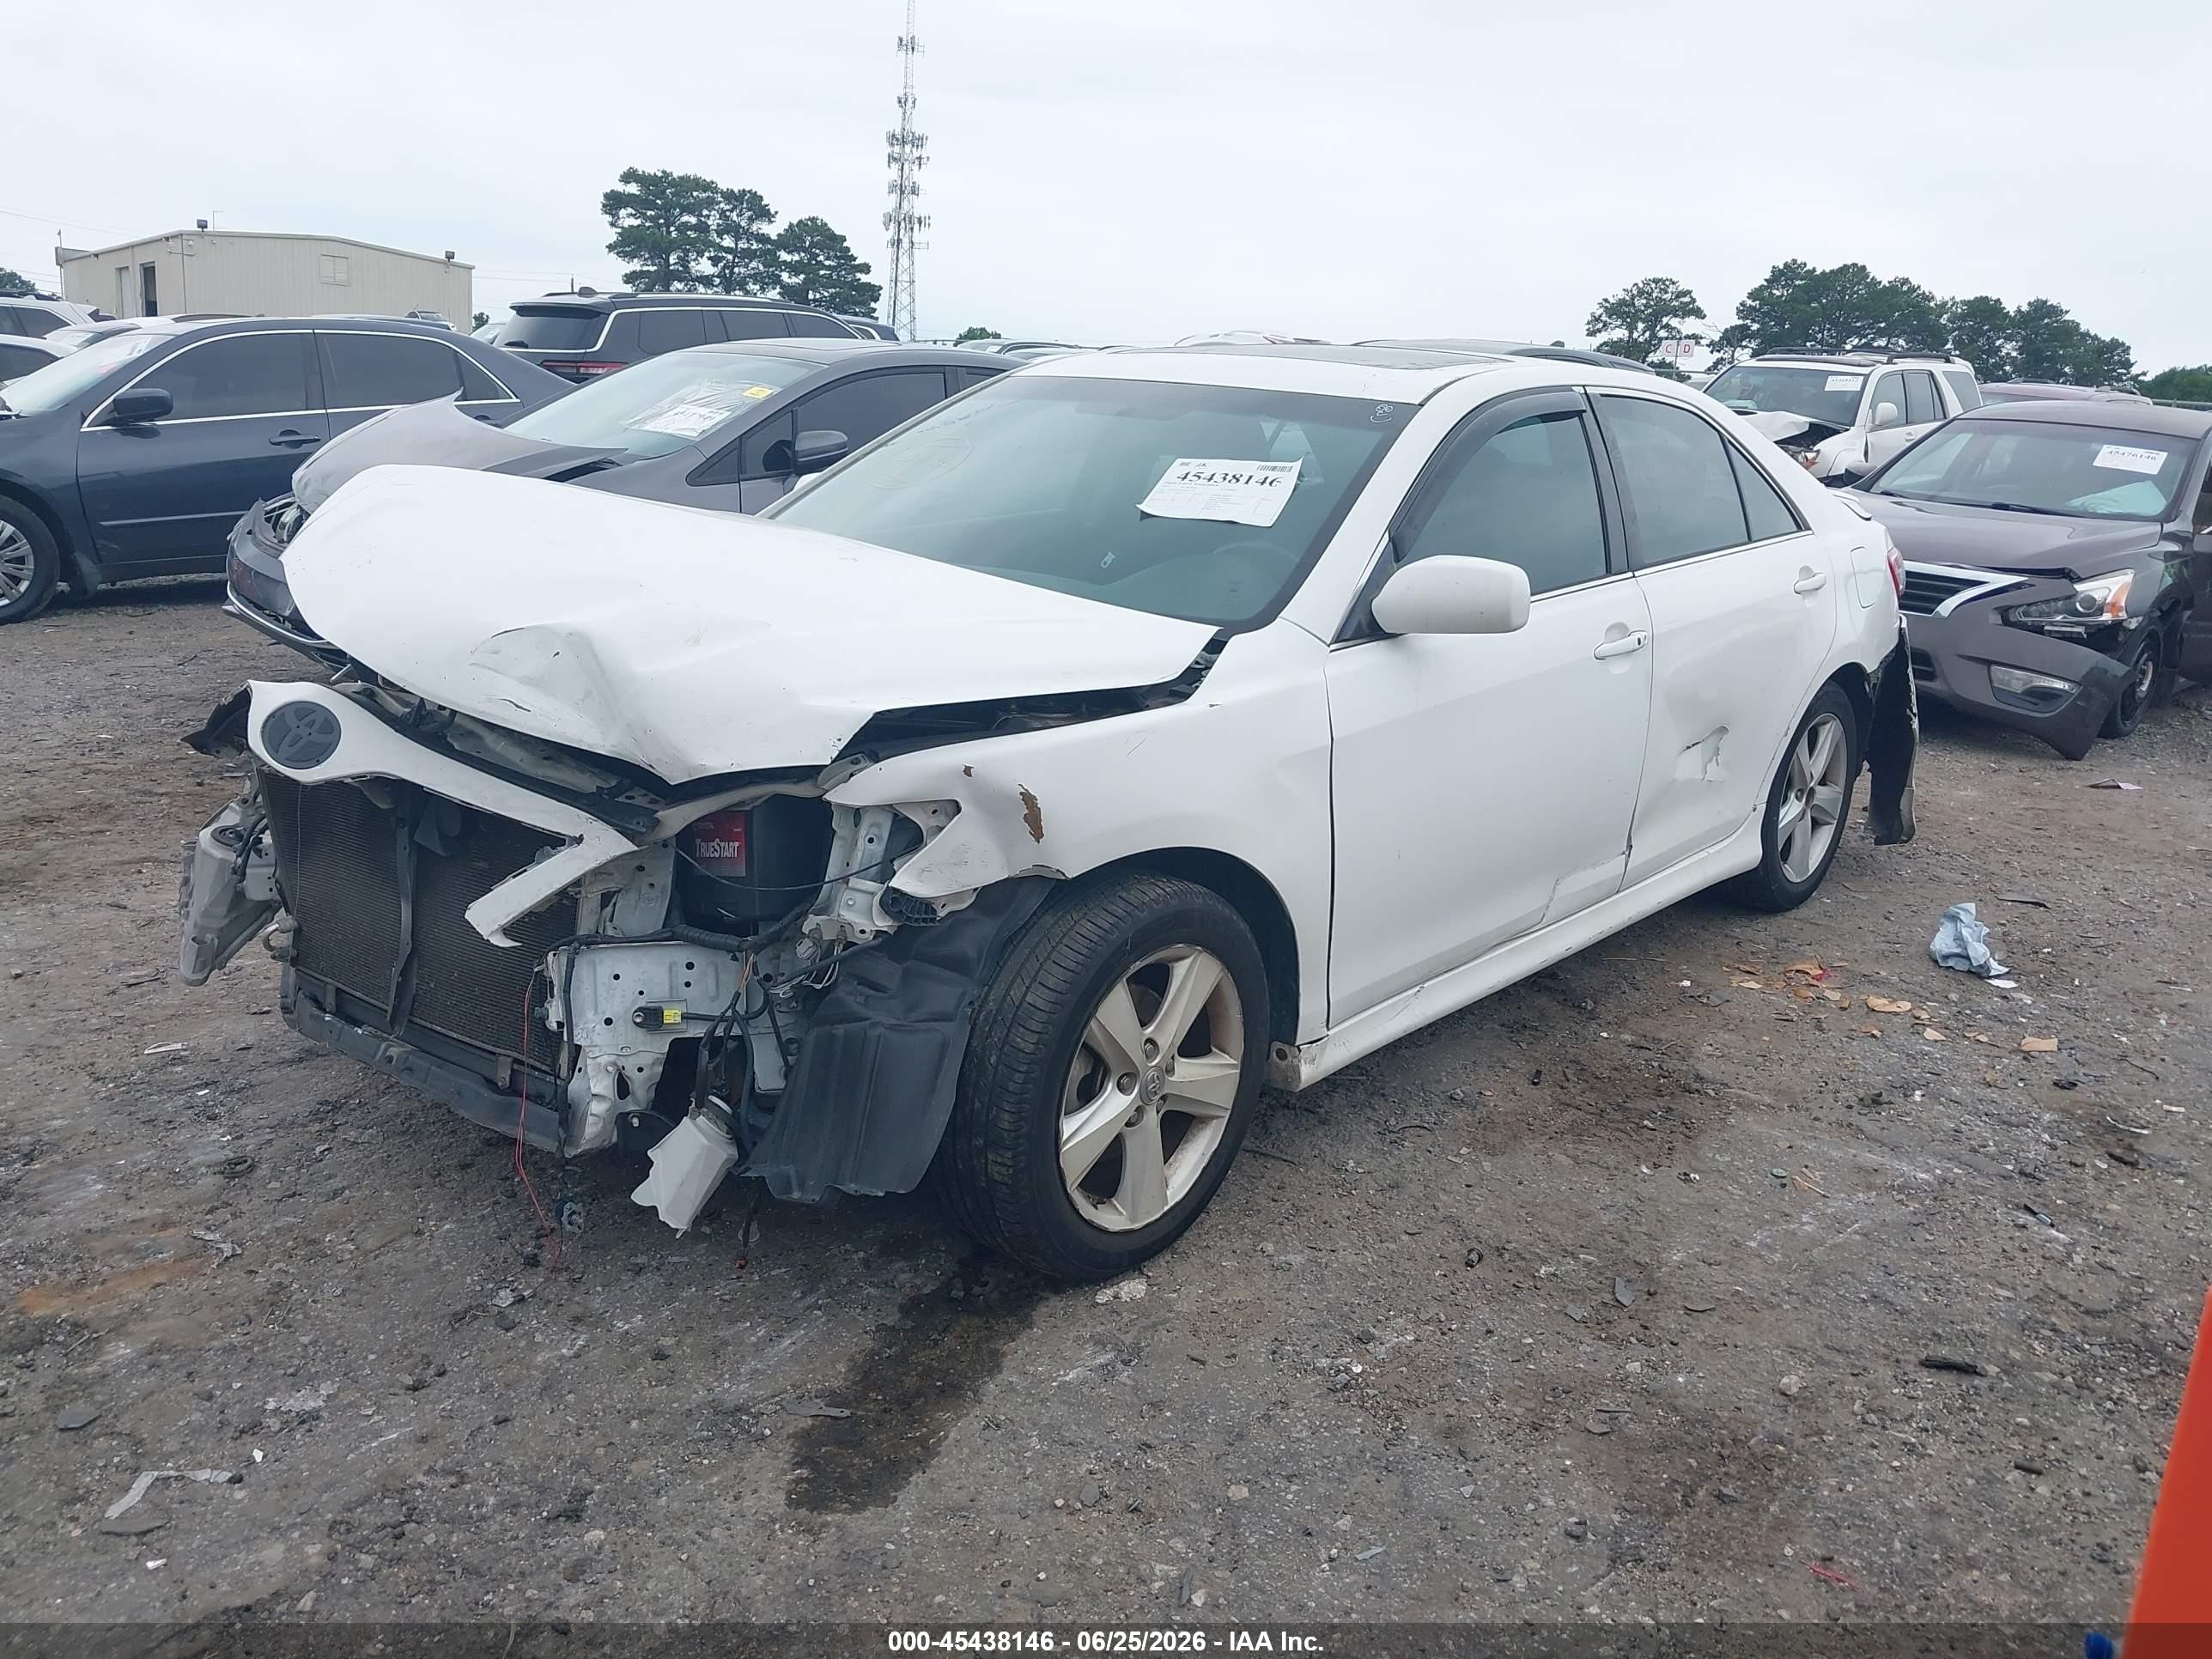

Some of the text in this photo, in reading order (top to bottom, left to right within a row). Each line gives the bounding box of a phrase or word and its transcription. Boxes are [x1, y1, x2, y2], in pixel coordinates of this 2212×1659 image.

[1665, 344, 1690, 353] C D
[1176, 471, 1285, 488] 45438146
